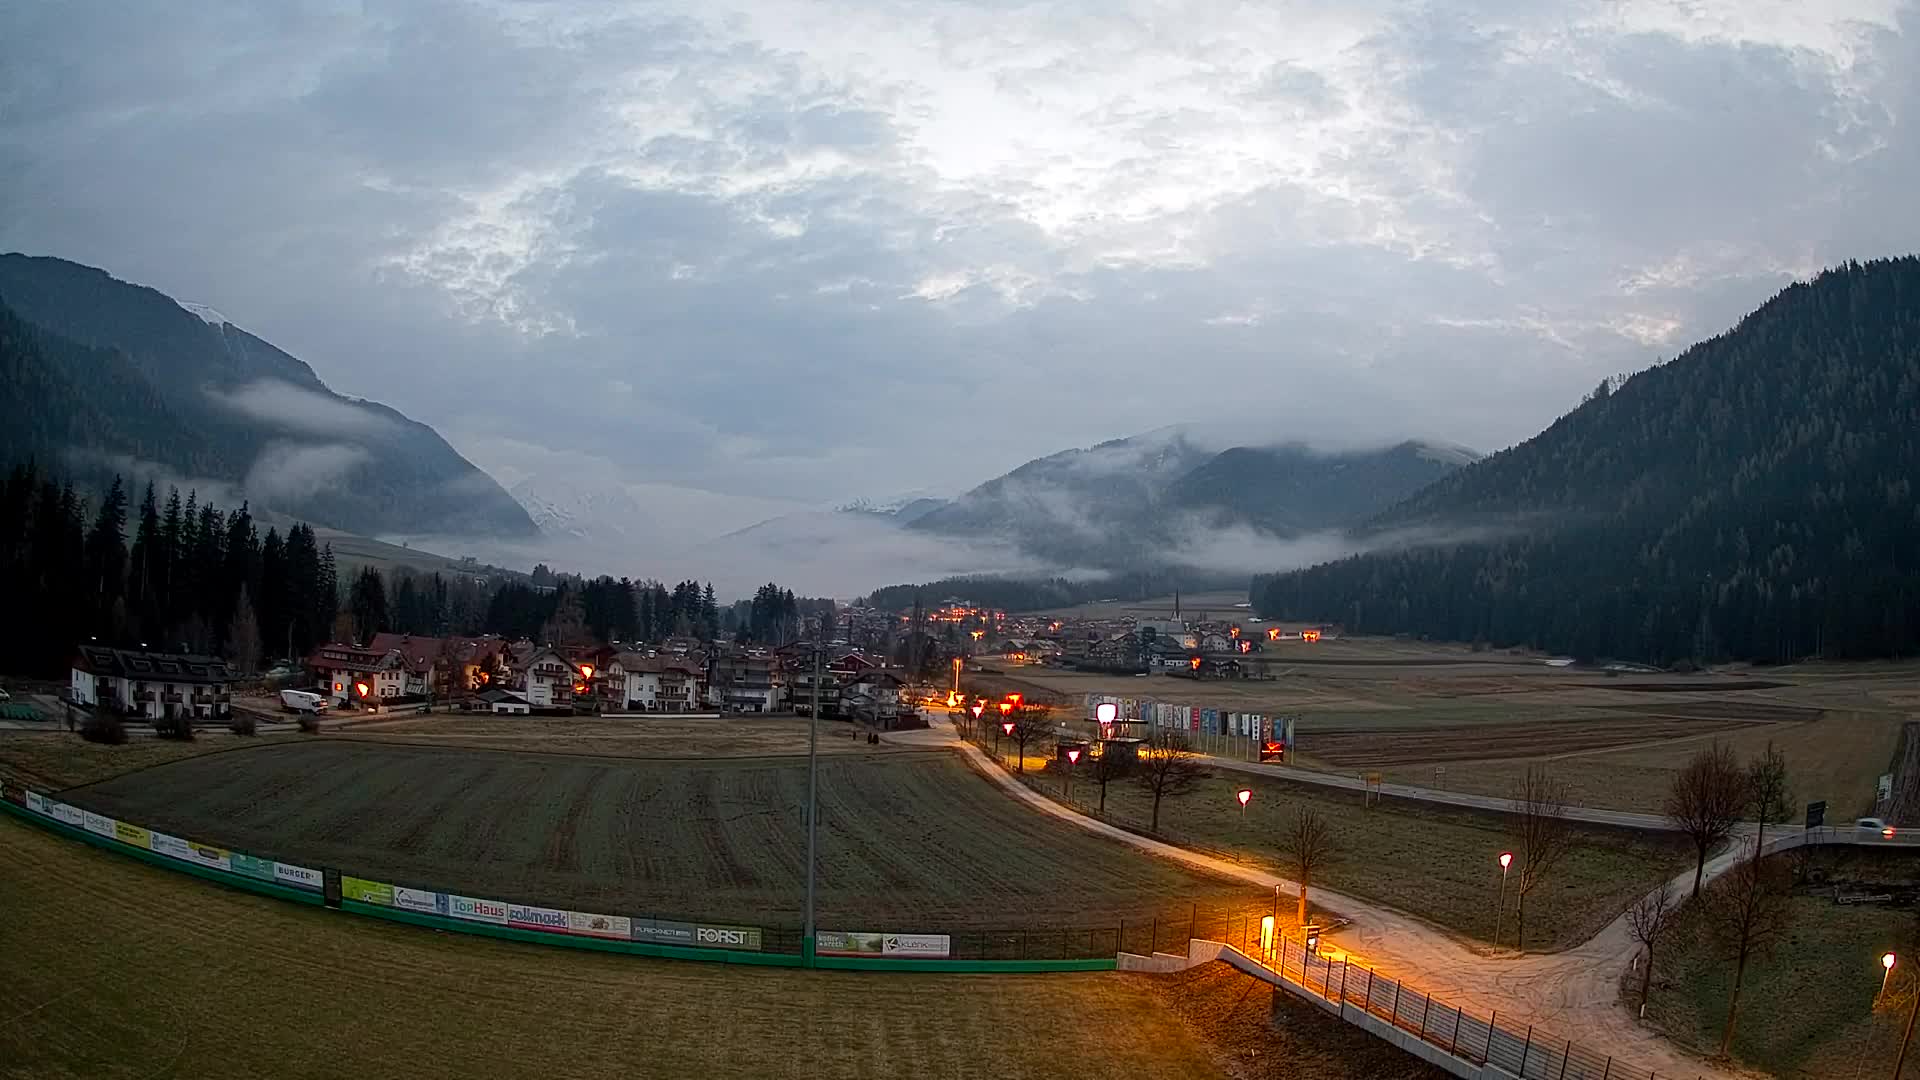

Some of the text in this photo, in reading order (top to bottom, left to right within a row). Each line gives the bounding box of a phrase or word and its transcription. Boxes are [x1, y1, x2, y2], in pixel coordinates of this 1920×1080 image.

[279, 866, 311, 880] BURGER
[454, 898, 505, 916] TopHaus
[697, 927, 748, 944] FORST
